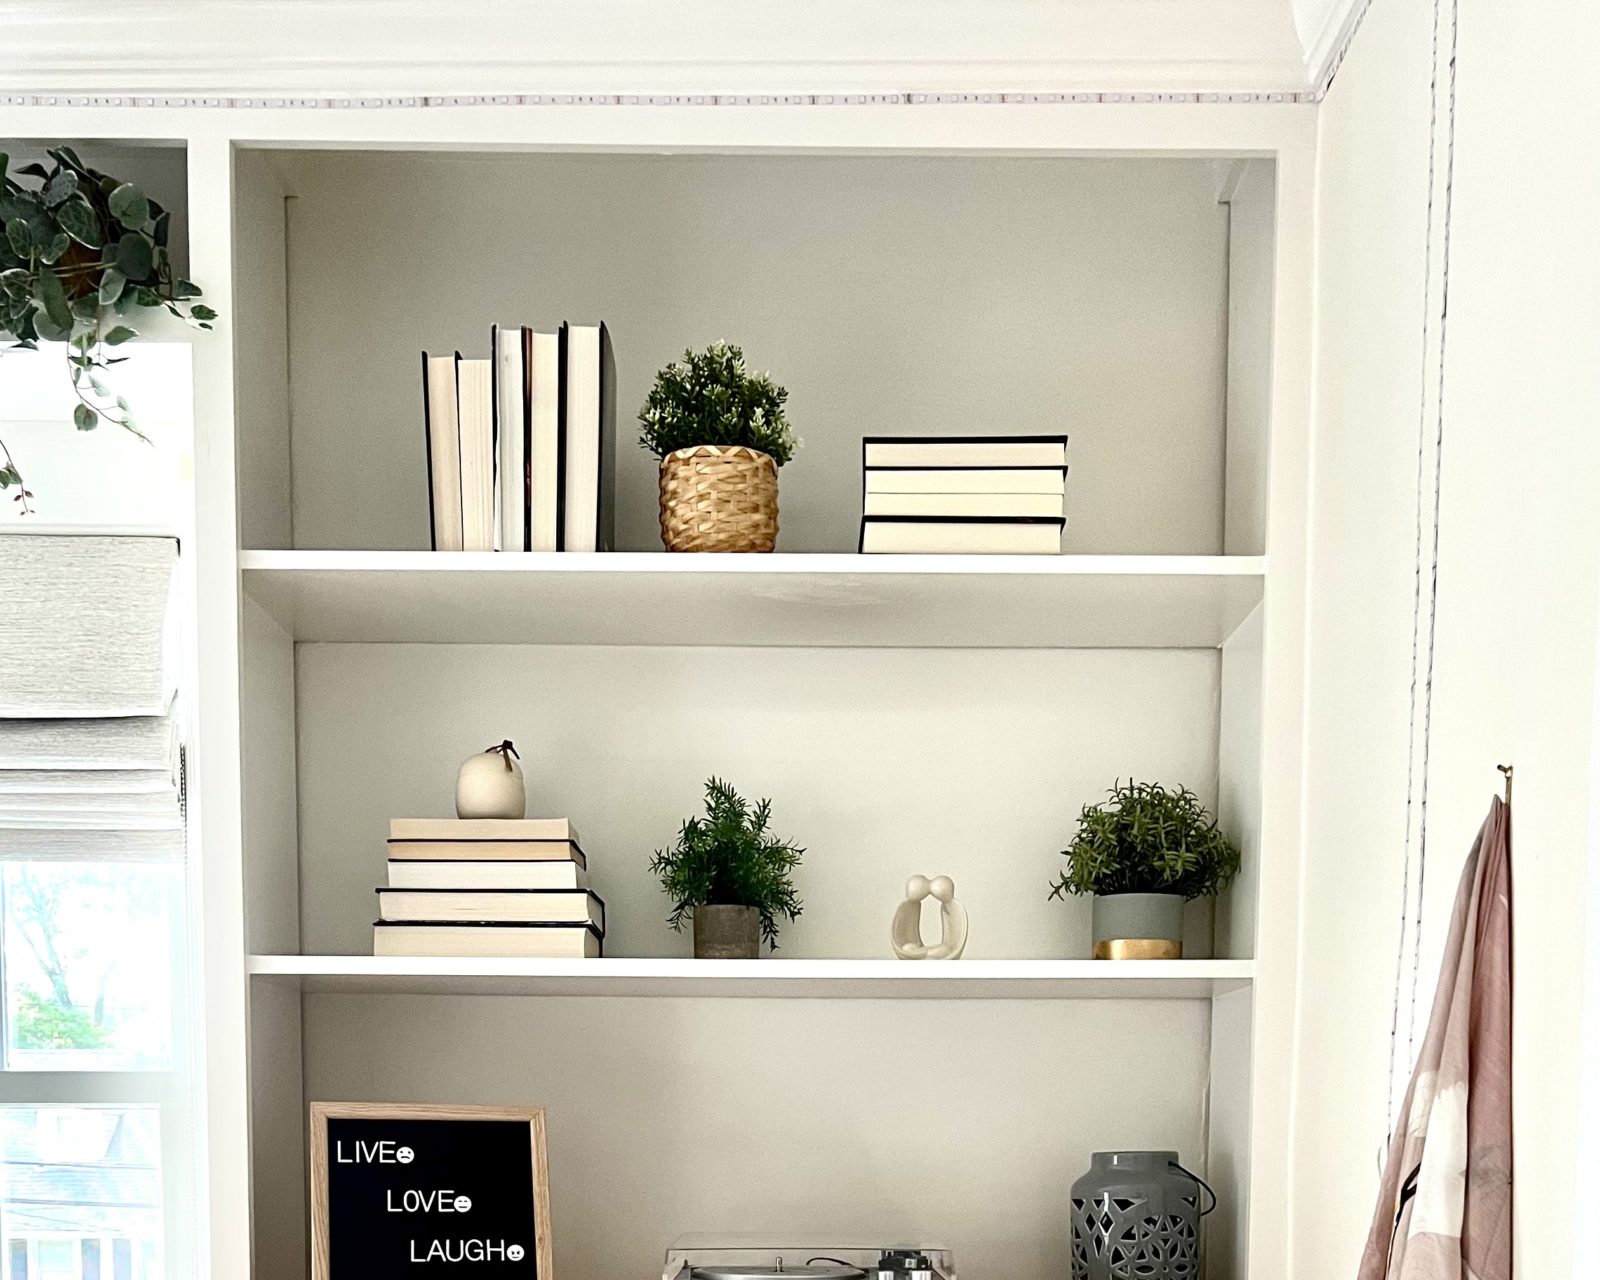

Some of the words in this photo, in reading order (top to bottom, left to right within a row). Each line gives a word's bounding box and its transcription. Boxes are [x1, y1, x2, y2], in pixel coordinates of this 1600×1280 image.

[337, 1140, 397, 1164] LIVE
[387, 1189, 455, 1213] LOVE
[410, 1239, 505, 1263] LAUGH
